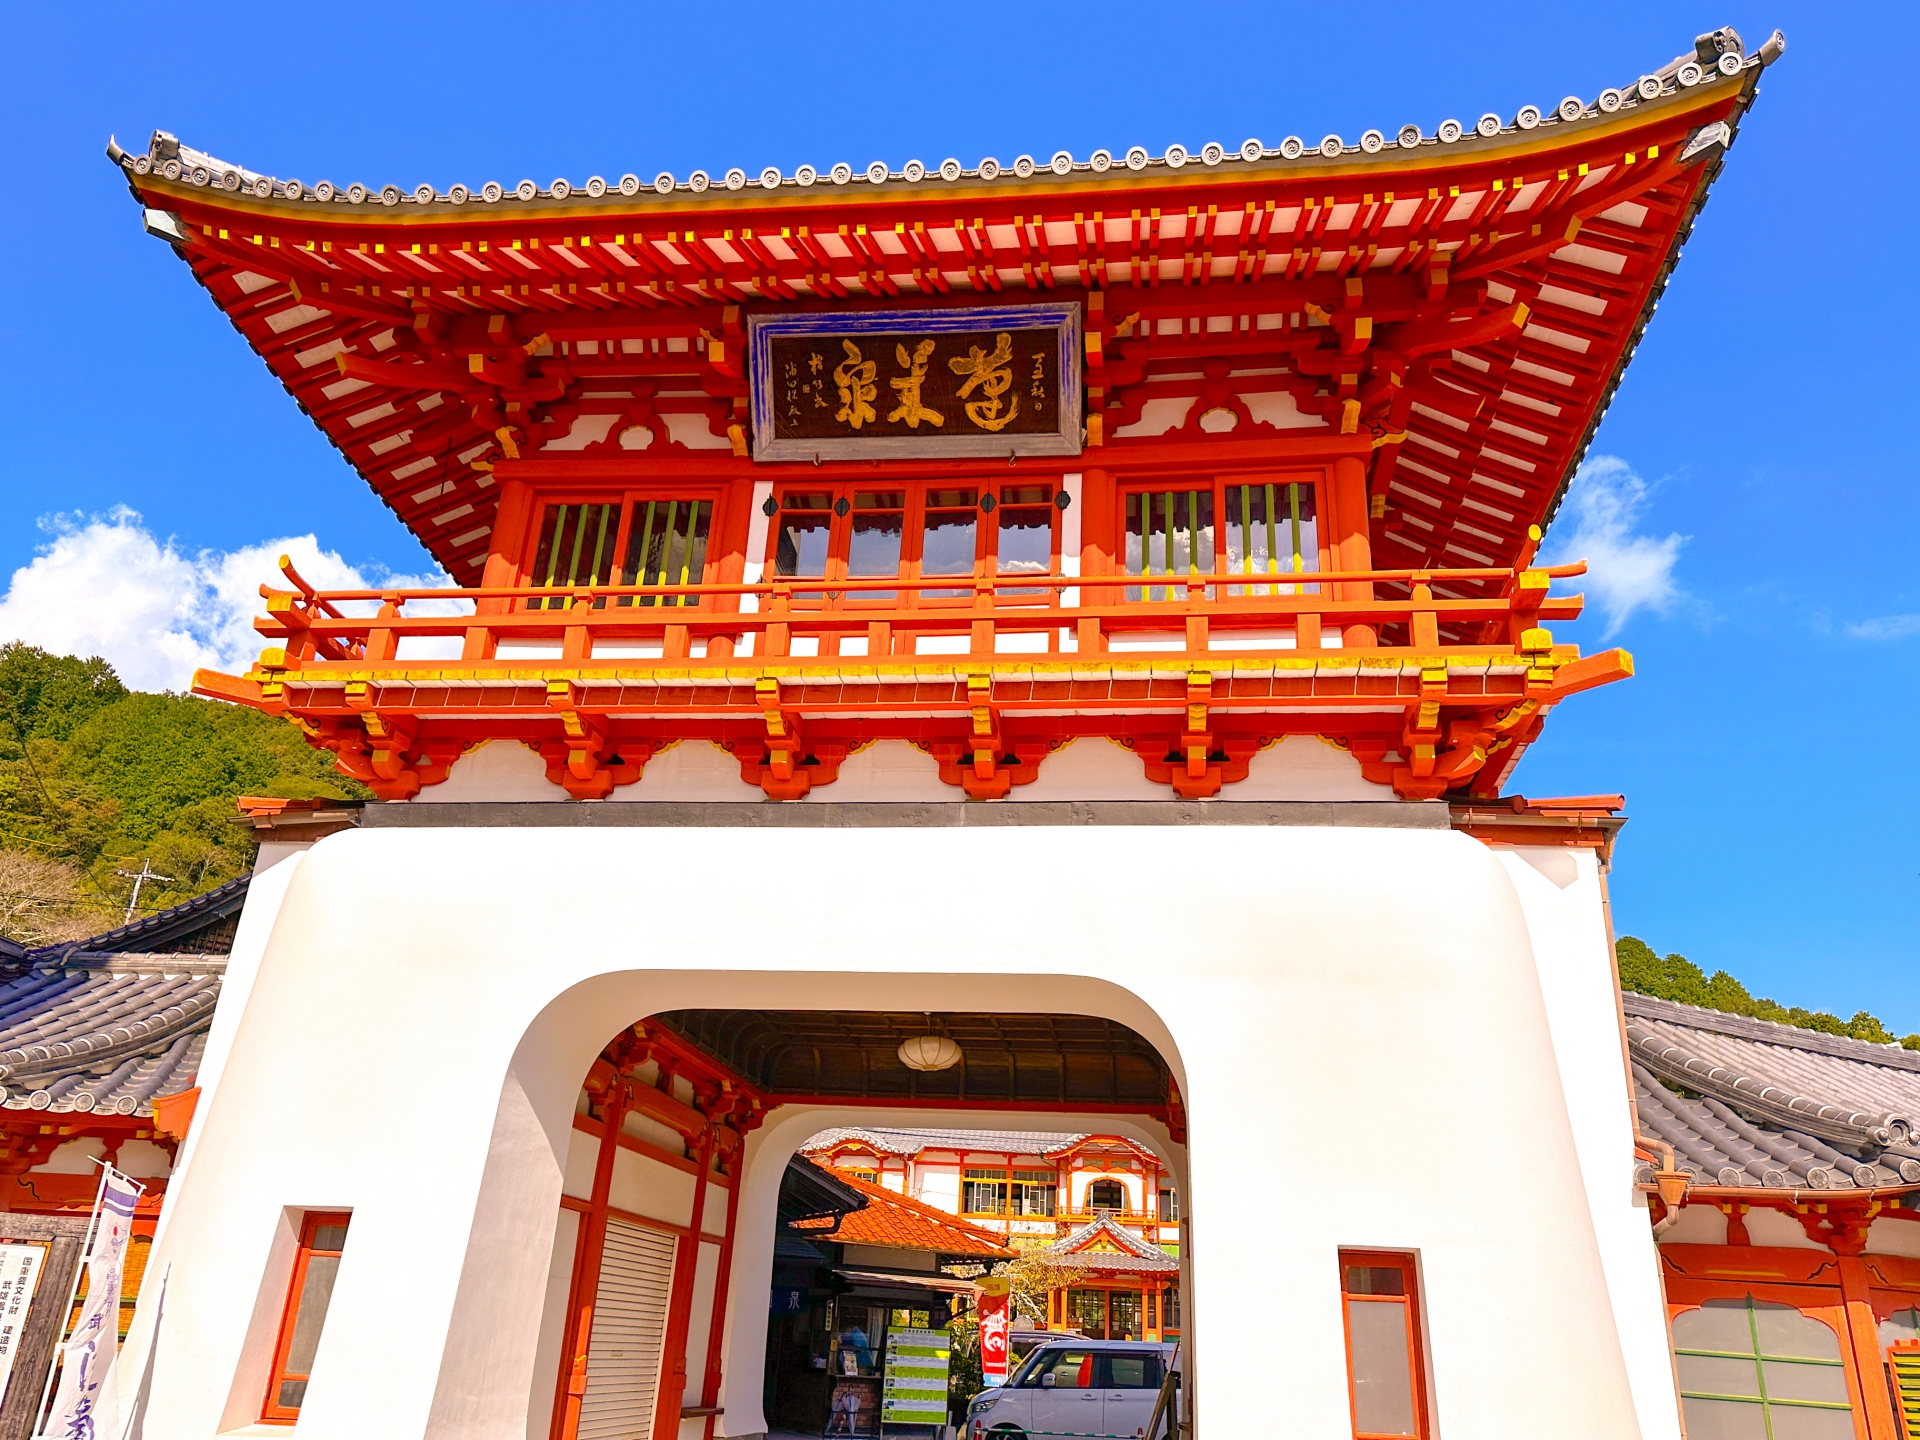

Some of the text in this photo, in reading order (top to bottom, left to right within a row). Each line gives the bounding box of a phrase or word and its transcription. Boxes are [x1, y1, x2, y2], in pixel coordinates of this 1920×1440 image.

[8, 1257, 33, 1314] 国重要文化財
